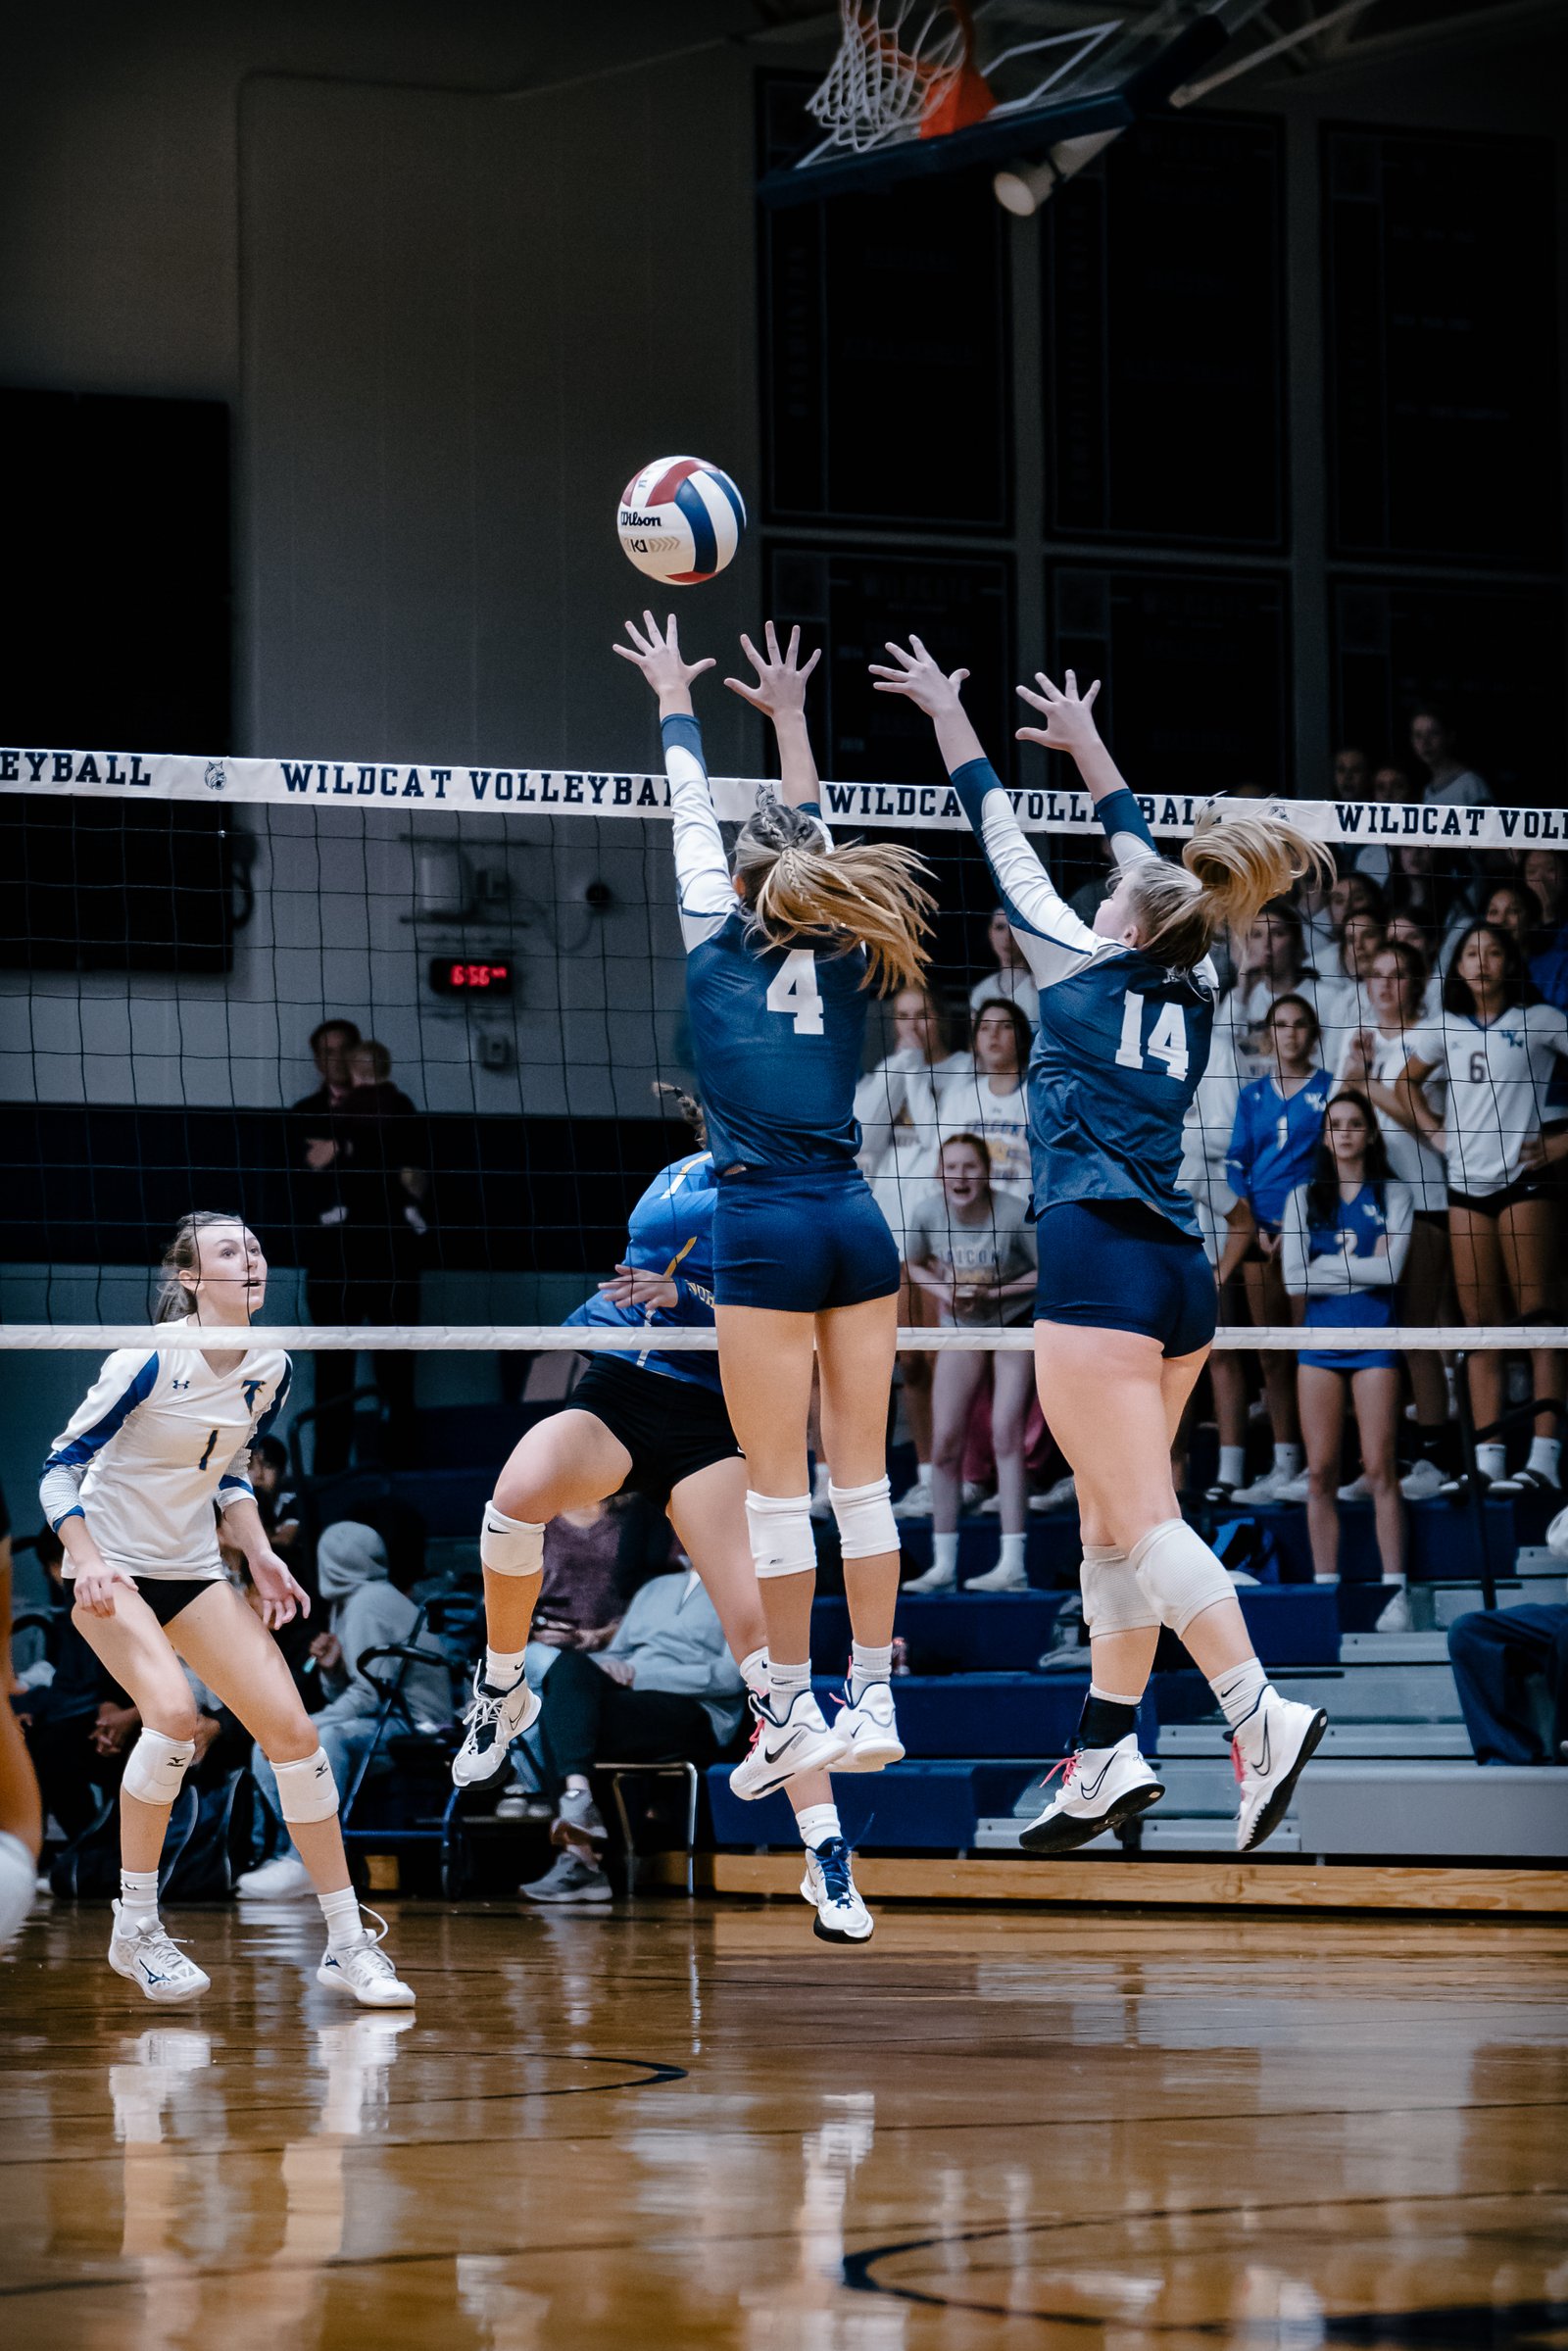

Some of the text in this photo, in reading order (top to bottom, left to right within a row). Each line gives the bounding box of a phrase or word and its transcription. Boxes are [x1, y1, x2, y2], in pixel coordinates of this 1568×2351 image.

[620, 511, 662, 526] Wilson
[0, 751, 151, 787] EYBALL
[280, 762, 671, 808] WILDCAT VOLLEYBA
[826, 784, 962, 817] WILDCA
[1335, 804, 1485, 837] WILDCAT
[766, 949, 824, 1035] 4
[1115, 989, 1190, 1082] 14
[1469, 1051, 1486, 1083] 6
[199, 1429, 219, 1471] 1
